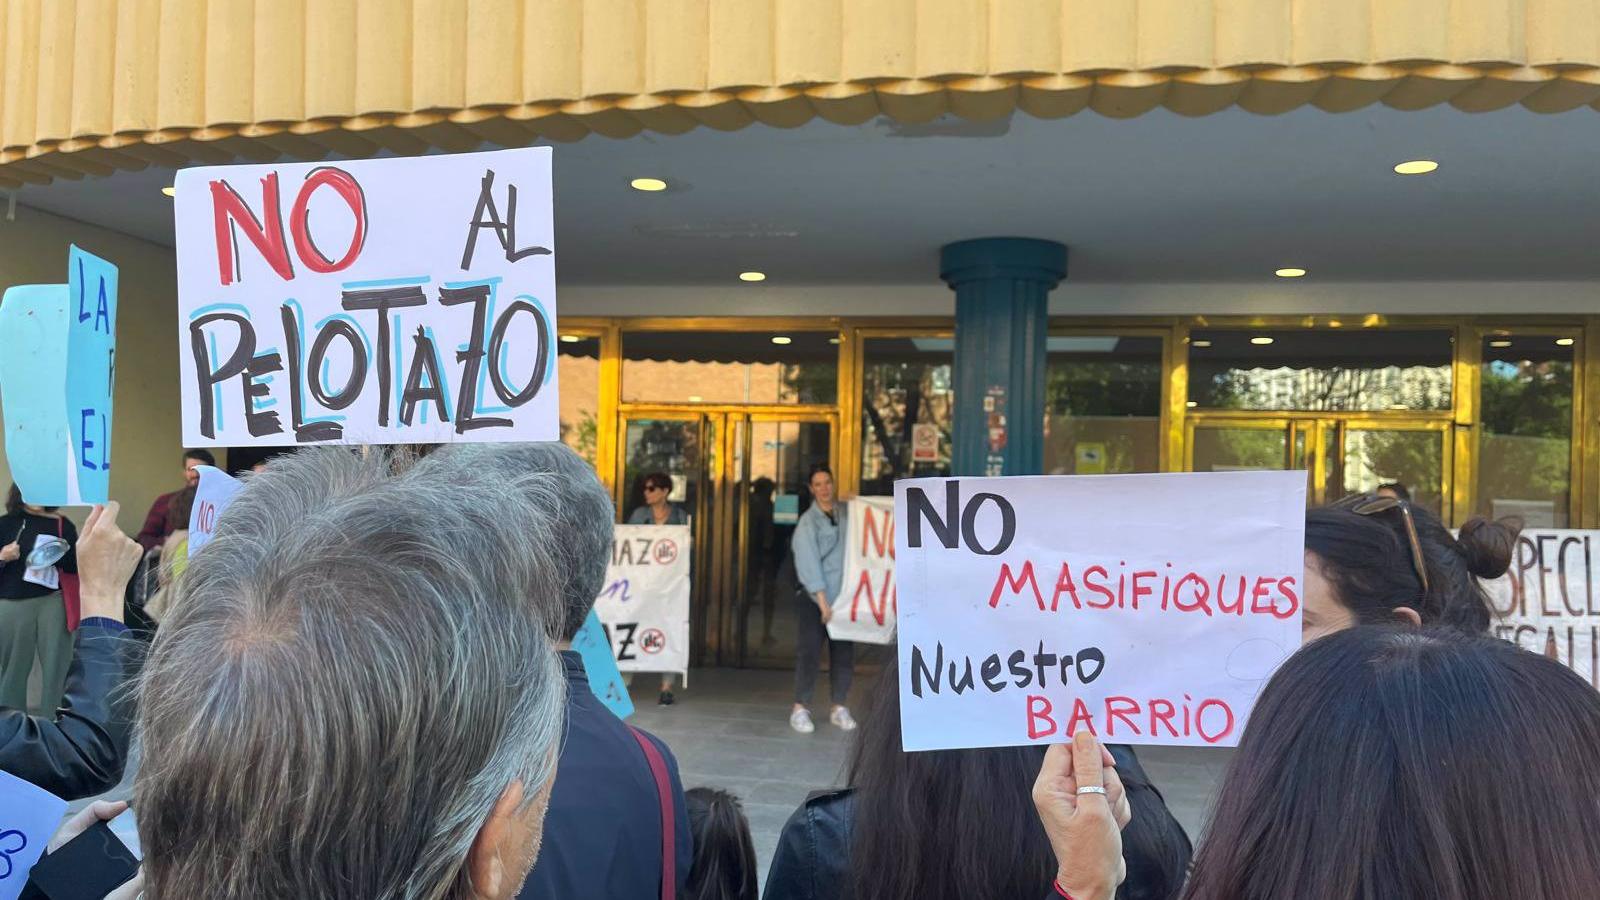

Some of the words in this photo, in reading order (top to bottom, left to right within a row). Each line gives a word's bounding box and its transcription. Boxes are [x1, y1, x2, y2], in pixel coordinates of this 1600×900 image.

[209, 166, 368, 286] NO
[460, 169, 552, 272] AL
[78, 256, 110, 334] LA
[189, 277, 554, 442] PELOTAZO
[197, 500, 215, 534] NO
[906, 480, 1016, 556] NO
[850, 570, 897, 626] N
[910, 640, 1106, 699] Nuestro
